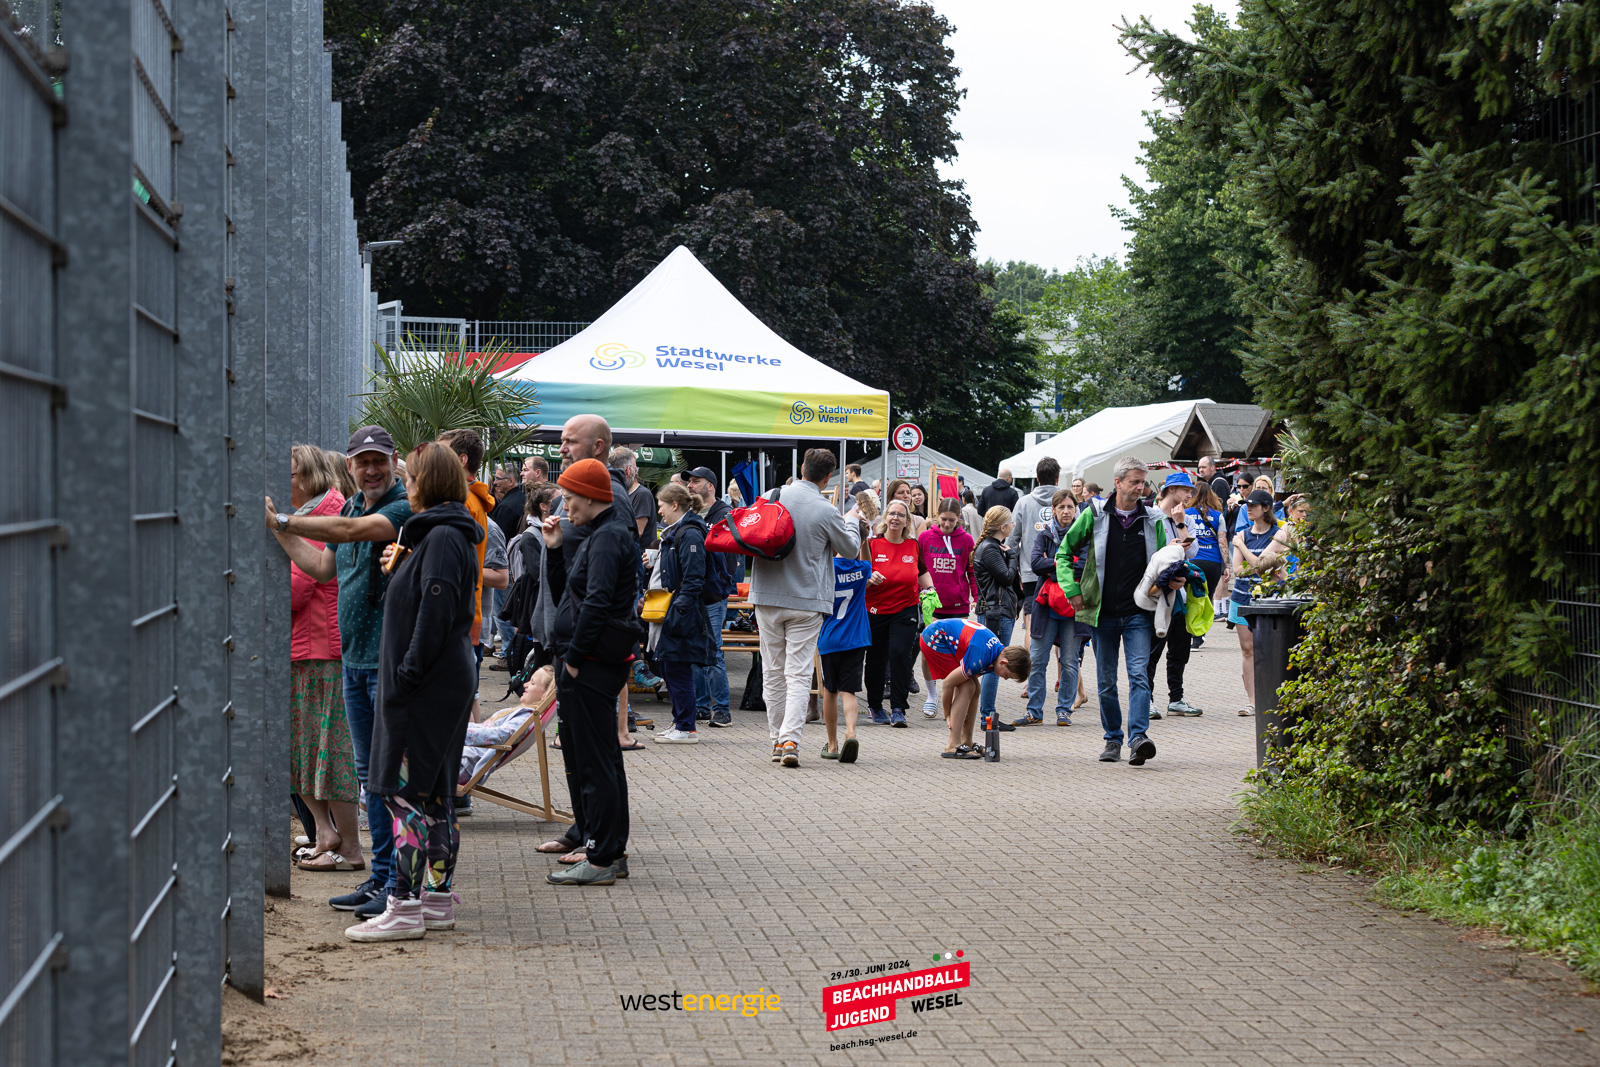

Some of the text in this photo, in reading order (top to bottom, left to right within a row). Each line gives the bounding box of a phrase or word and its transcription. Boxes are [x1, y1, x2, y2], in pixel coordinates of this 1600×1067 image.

[655, 345, 782, 367] Stadtwerke
[655, 357, 725, 372] Wesel
[818, 404, 874, 416] Stadtwerke
[818, 414, 848, 424] Wesel
[929, 544, 963, 556] humel
[933, 557, 957, 571] 1923
[837, 570, 864, 583] WESEL
[834, 588, 854, 620] 7
